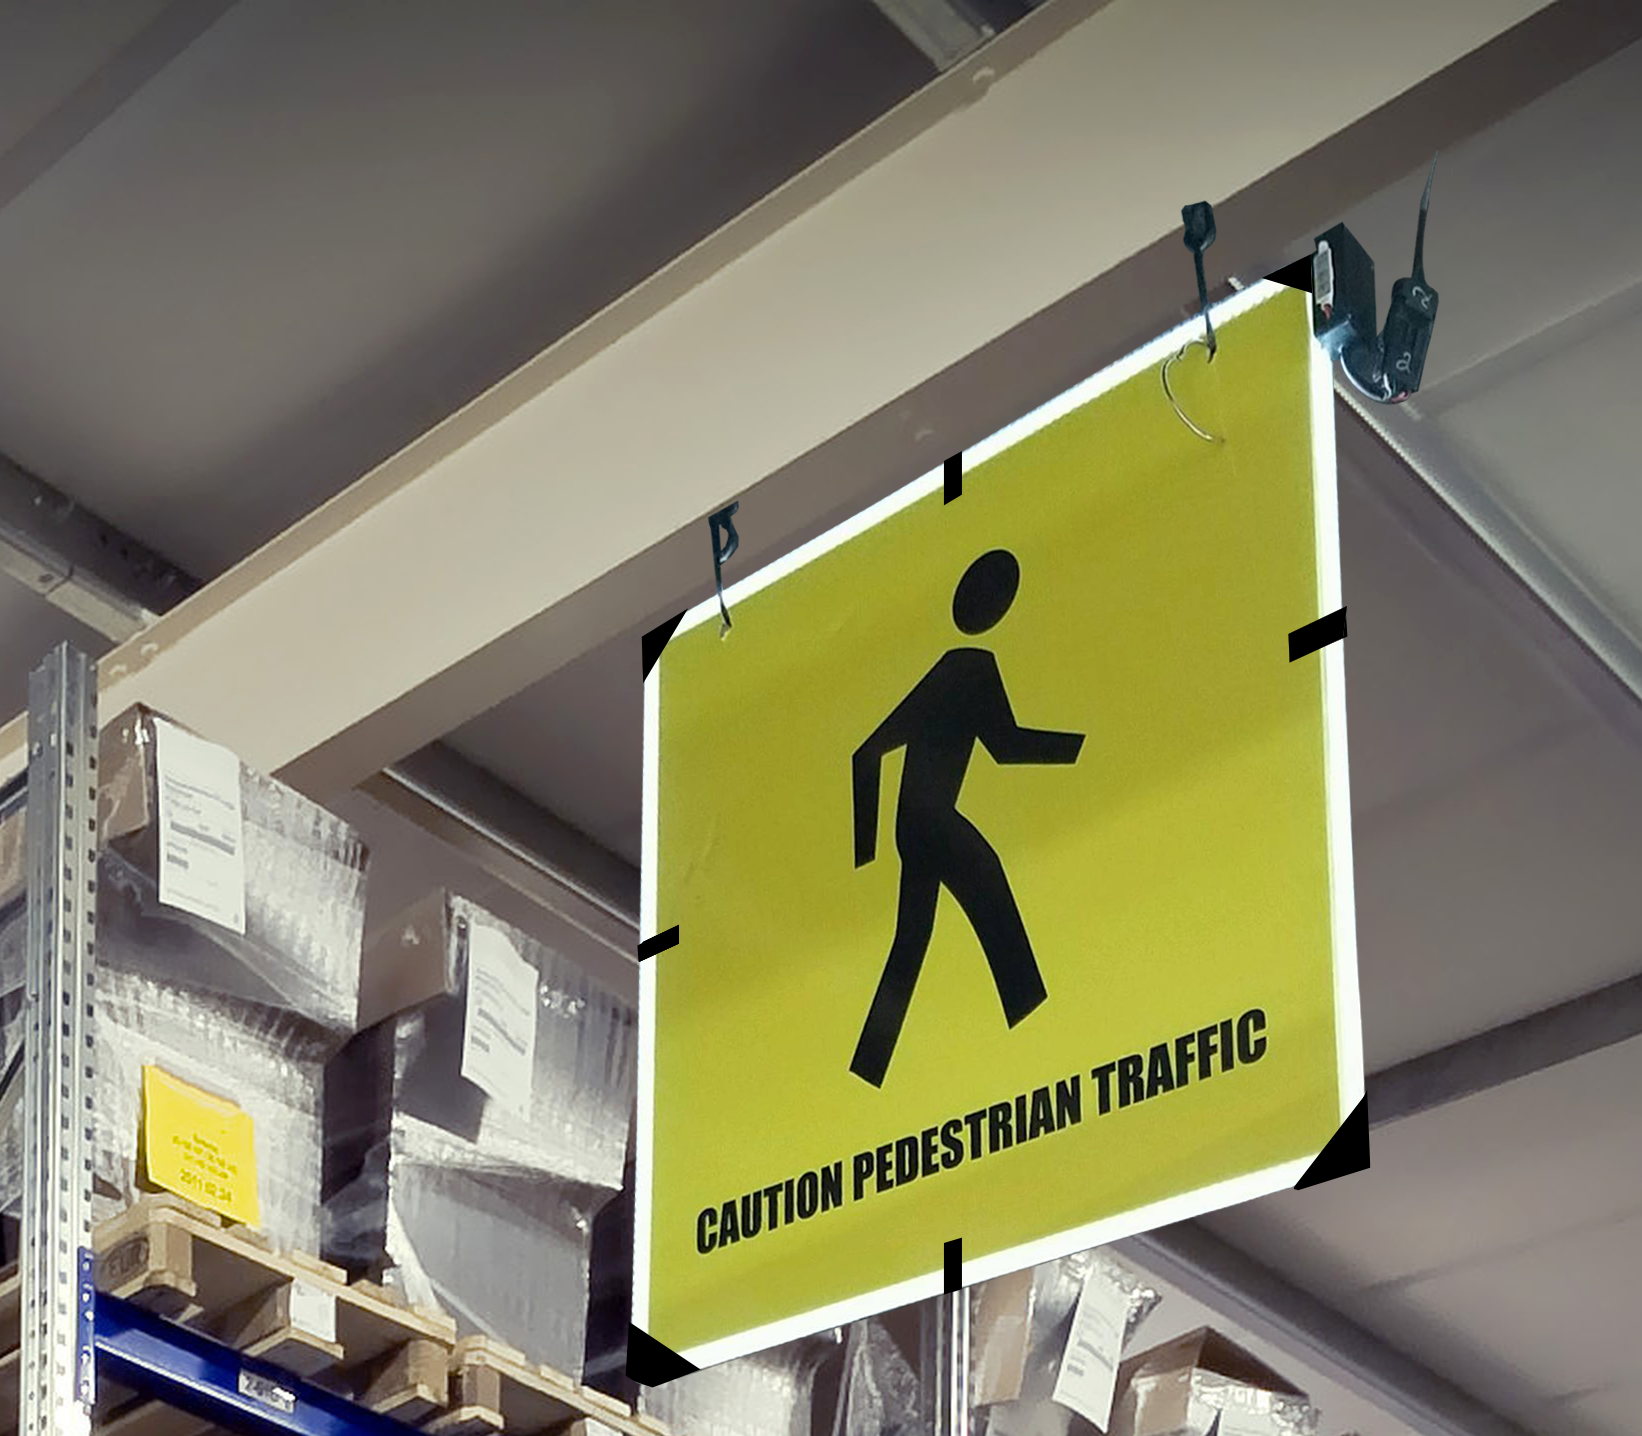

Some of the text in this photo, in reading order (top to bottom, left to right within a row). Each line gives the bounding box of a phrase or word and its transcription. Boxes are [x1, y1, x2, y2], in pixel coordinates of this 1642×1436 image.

[696, 1008, 1267, 1254] CAUTION PEDESTRIAN TRAFFIC
